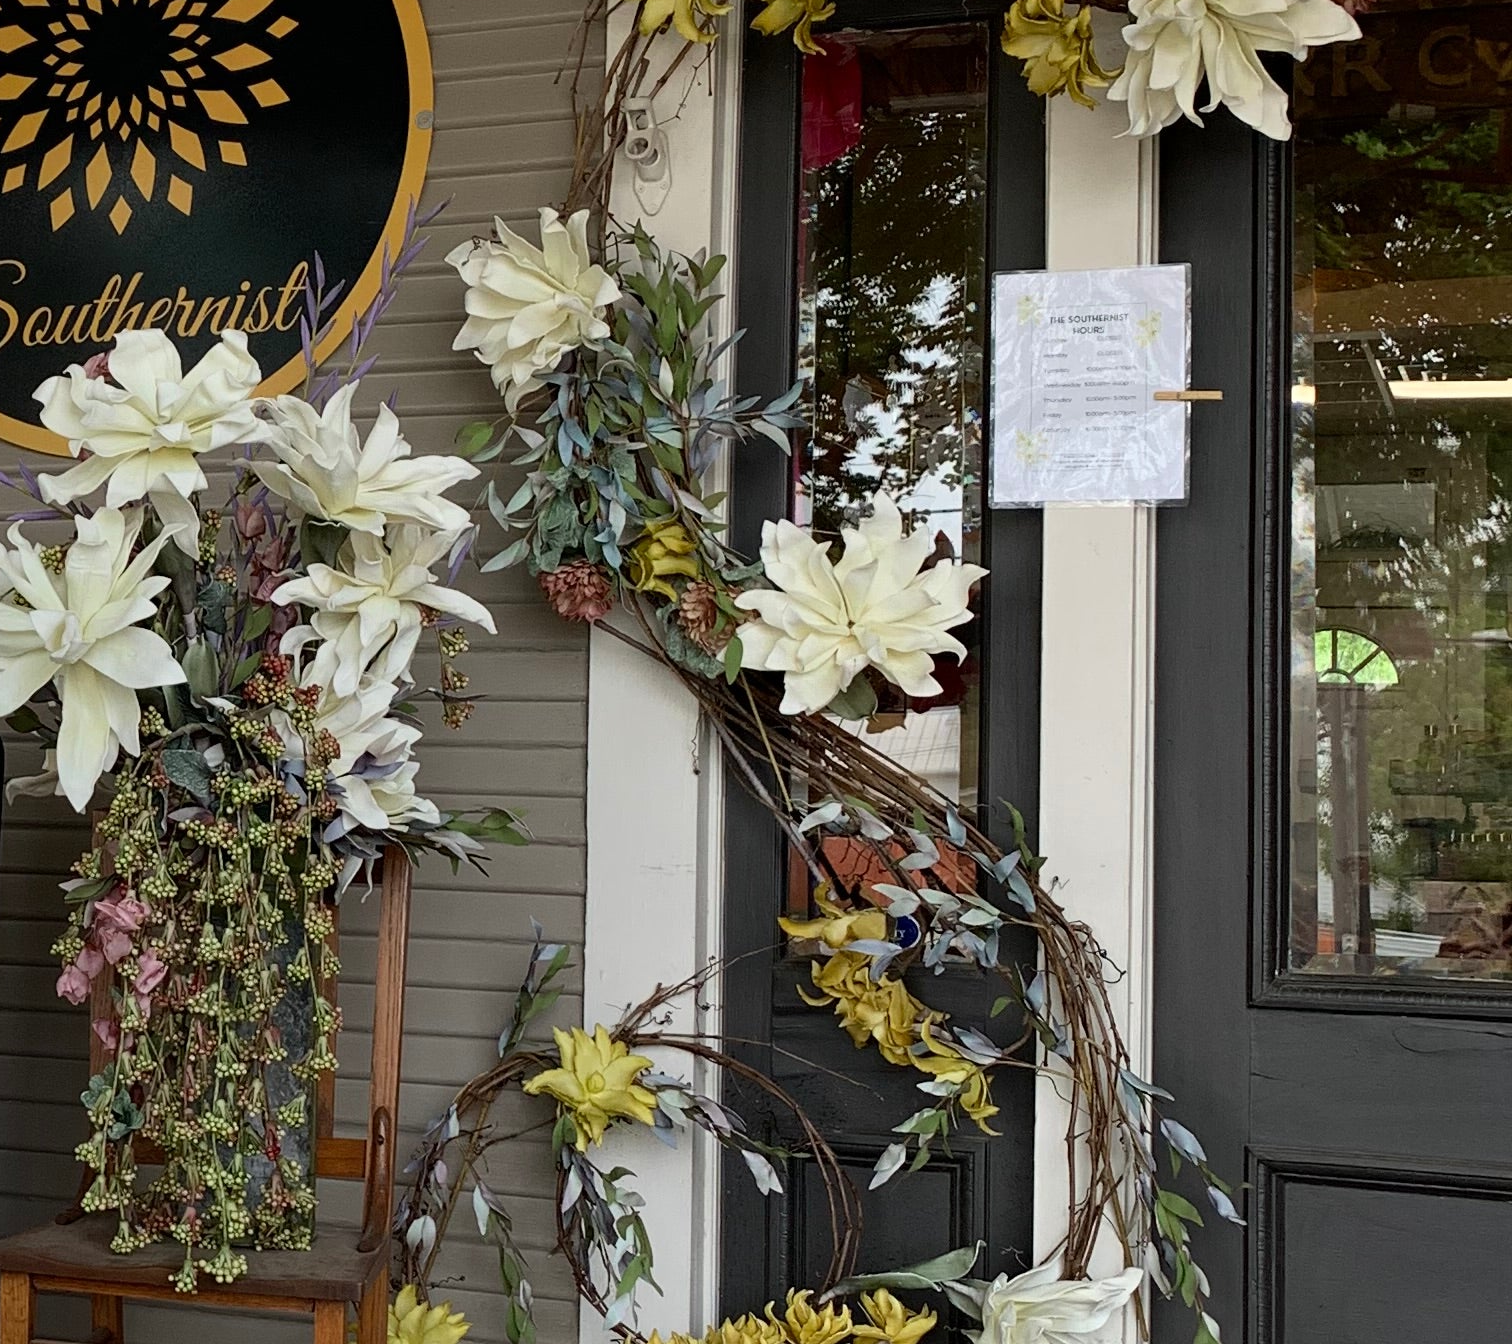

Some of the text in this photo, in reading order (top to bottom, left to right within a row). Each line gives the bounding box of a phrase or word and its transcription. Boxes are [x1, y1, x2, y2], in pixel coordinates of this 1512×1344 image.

[1050, 313, 1129, 324] THE SOUTHERNIST
[1072, 326, 1105, 335] HOURS
